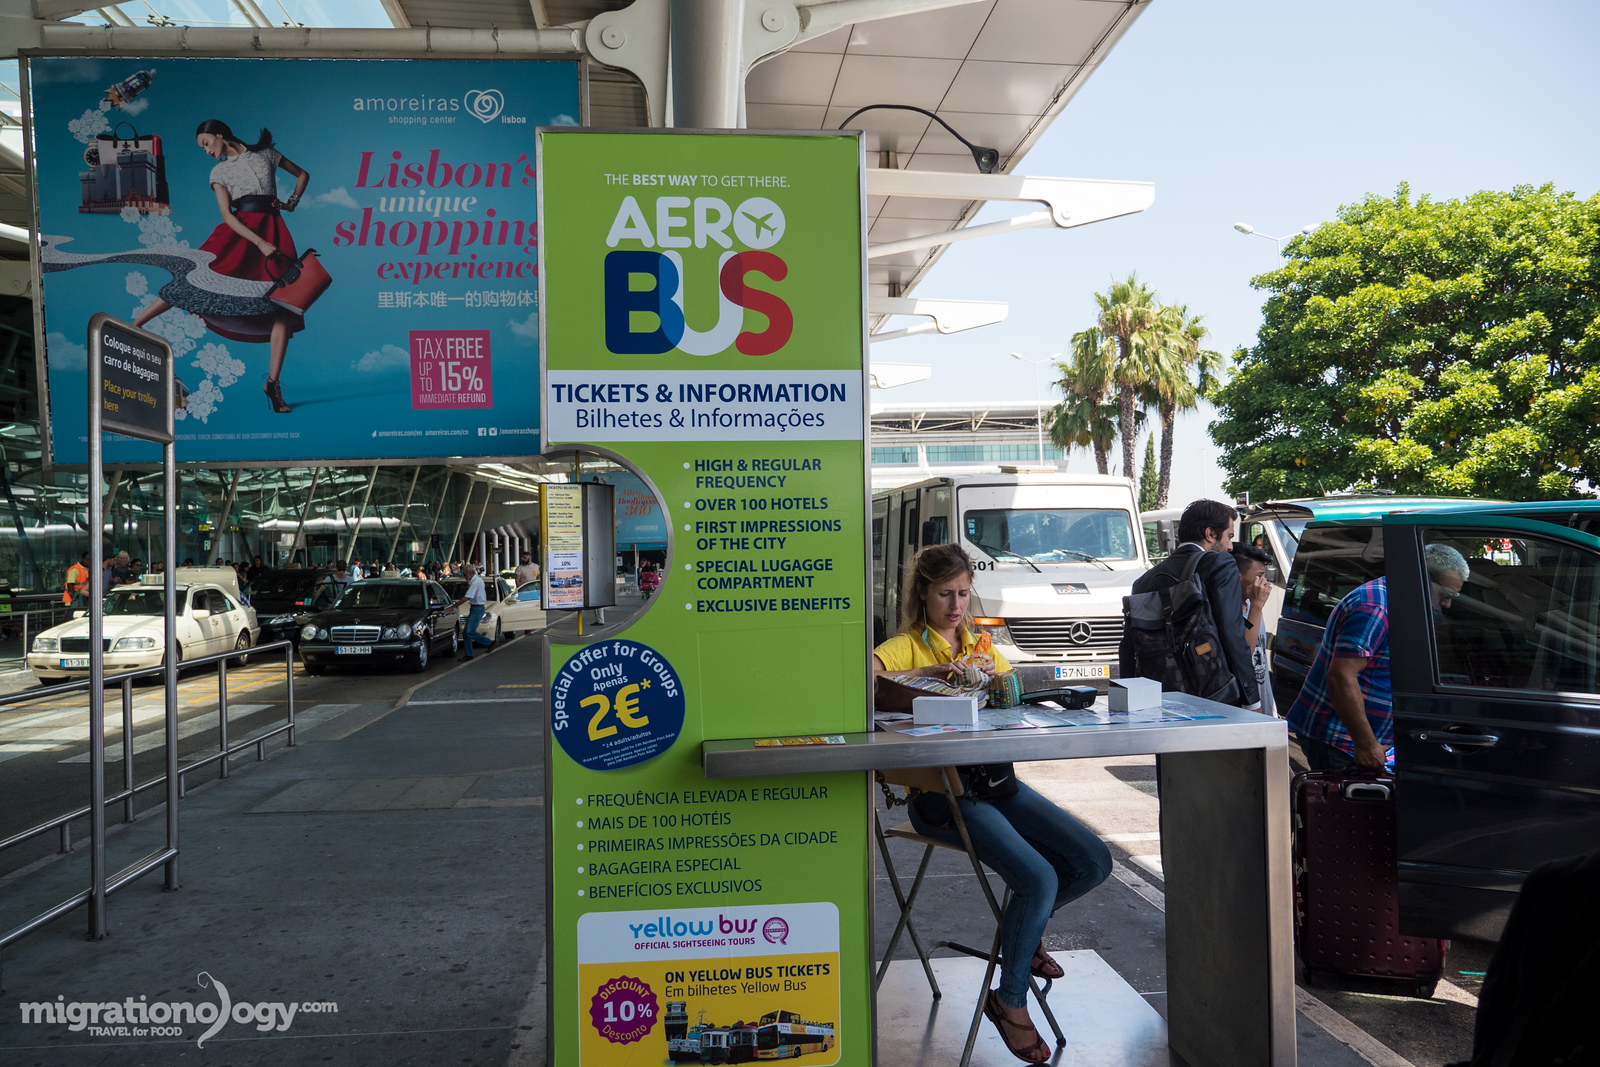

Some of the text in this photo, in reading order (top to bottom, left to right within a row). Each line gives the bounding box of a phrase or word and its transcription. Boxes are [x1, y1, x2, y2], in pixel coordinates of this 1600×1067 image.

[354, 95, 459, 111] amoreiras
[389, 116, 426, 125] shopping
[502, 116, 526, 124] lisboa
[604, 174, 790, 188] THE BEST WAY TO GET THERE.
[380, 190, 477, 218] unique
[605, 195, 786, 249] AERO
[604, 250, 793, 356] BUS
[104, 335, 131, 354] Coloque
[132, 347, 146, 360] aqui
[151, 355, 161, 365] seu
[416, 338, 483, 359] TAX FREE
[104, 355, 160, 382] carro de bagagem
[419, 362, 432, 376] UP
[439, 361, 483, 391] 15%
[104, 379, 157, 408] Place your trolley
[420, 377, 432, 392] TO
[552, 383, 846, 403] TICKETS & INFORMATION
[104, 398, 119, 412] here
[419, 393, 486, 404] IMMEDIATE REFUND
[576, 408, 825, 432] Bilhetes & Informações
[695, 458, 822, 472] HIGH & REGULAR
[696, 475, 786, 491] FREQUENCY
[695, 497, 828, 511] OVER 100 HOTELS
[696, 519, 841, 534] FIRST IMPRESSIONS
[697, 537, 787, 551] OF THE CITY
[696, 558, 833, 573] SPECIAL LUGAGGE
[697, 575, 814, 590] COMPARTMENT
[696, 597, 850, 612] EXCLUSIVE BENEFITS
[591, 662, 623, 680] Only
[554, 642, 678, 731] Special Offer for Groups
[593, 675, 628, 692] Apenas
[614, 731, 651, 745] adults/adultos
[587, 786, 828, 807] FREQUÊNCIA ELEVADA E REGULAR
[588, 812, 731, 830] MAIS DE 100 HOTÉIS
[588, 831, 838, 853] PRIMEIRAS IMPRESSÕES DA CIDADE
[589, 858, 741, 876] BAGAGEIRA ESPECIAL
[589, 879, 762, 899] BENEFÍCIOS EXCLUSIVOS
[629, 914, 757, 939] yellow bus
[635, 937, 756, 950] OFFICIAL SIGHTSEEING TOURS
[665, 964, 830, 983] ON YELLOW BUS TICKETS
[599, 980, 650, 1000] DISCOUNT
[665, 980, 806, 998] Em bilhetes Yellow Bus
[603, 1000, 653, 1023] 10%
[602, 1024, 647, 1041] Desconto
